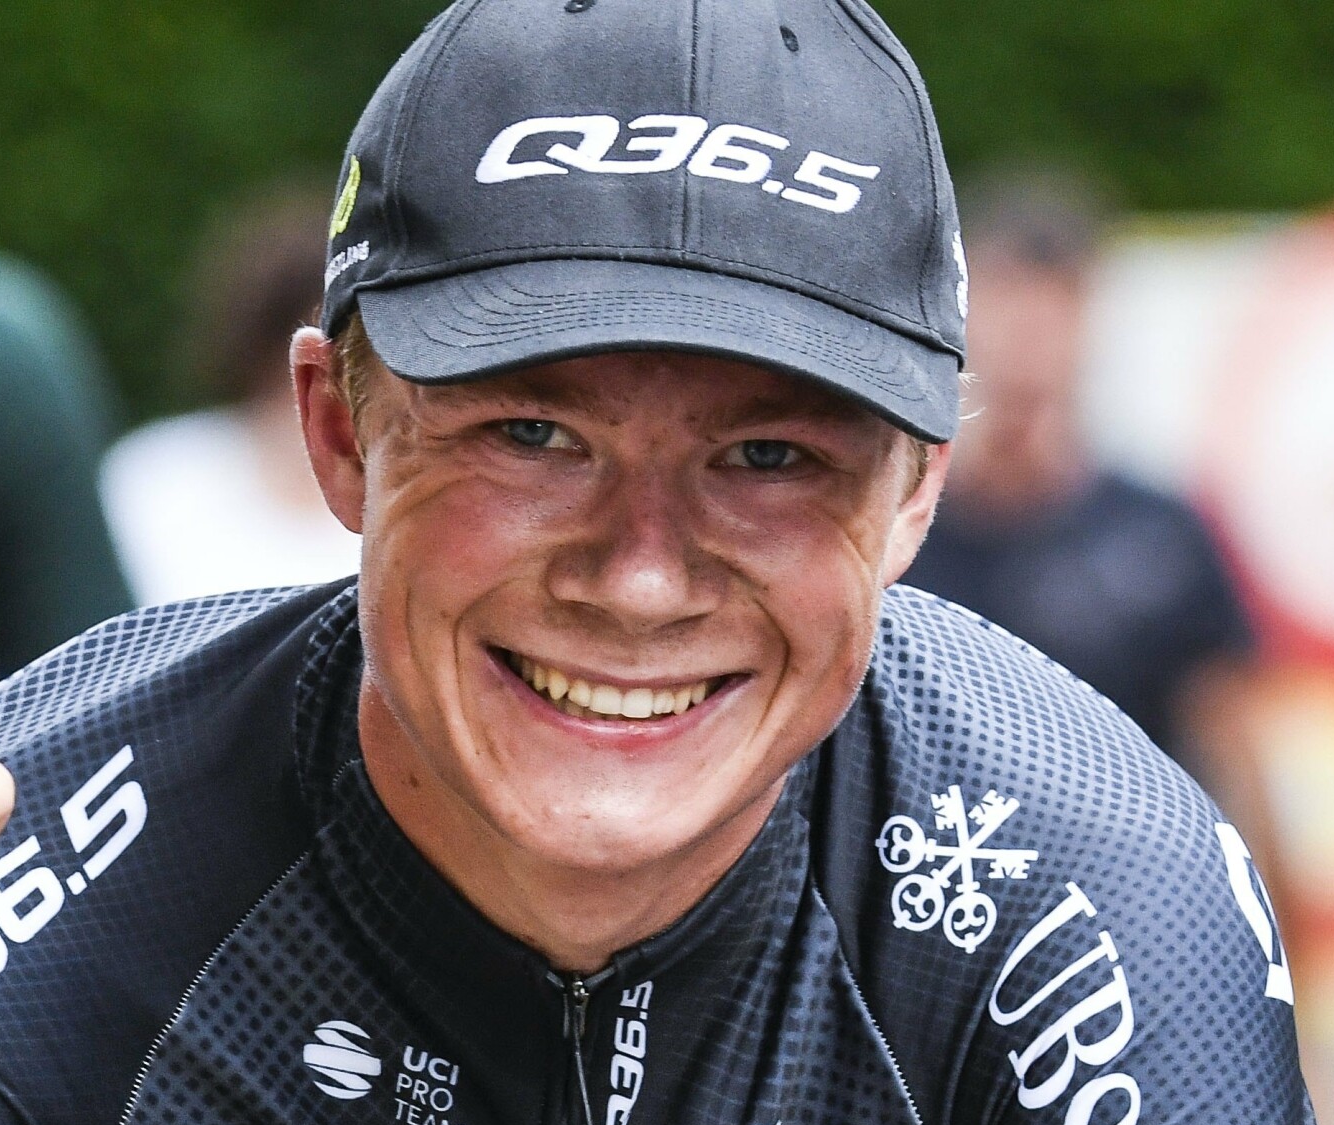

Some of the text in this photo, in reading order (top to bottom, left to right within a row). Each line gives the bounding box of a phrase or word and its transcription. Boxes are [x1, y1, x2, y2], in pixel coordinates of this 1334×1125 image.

[475, 114, 880, 214] Q36.5
[403, 1045, 459, 1086] UCI
[396, 1073, 454, 1112] PRO
